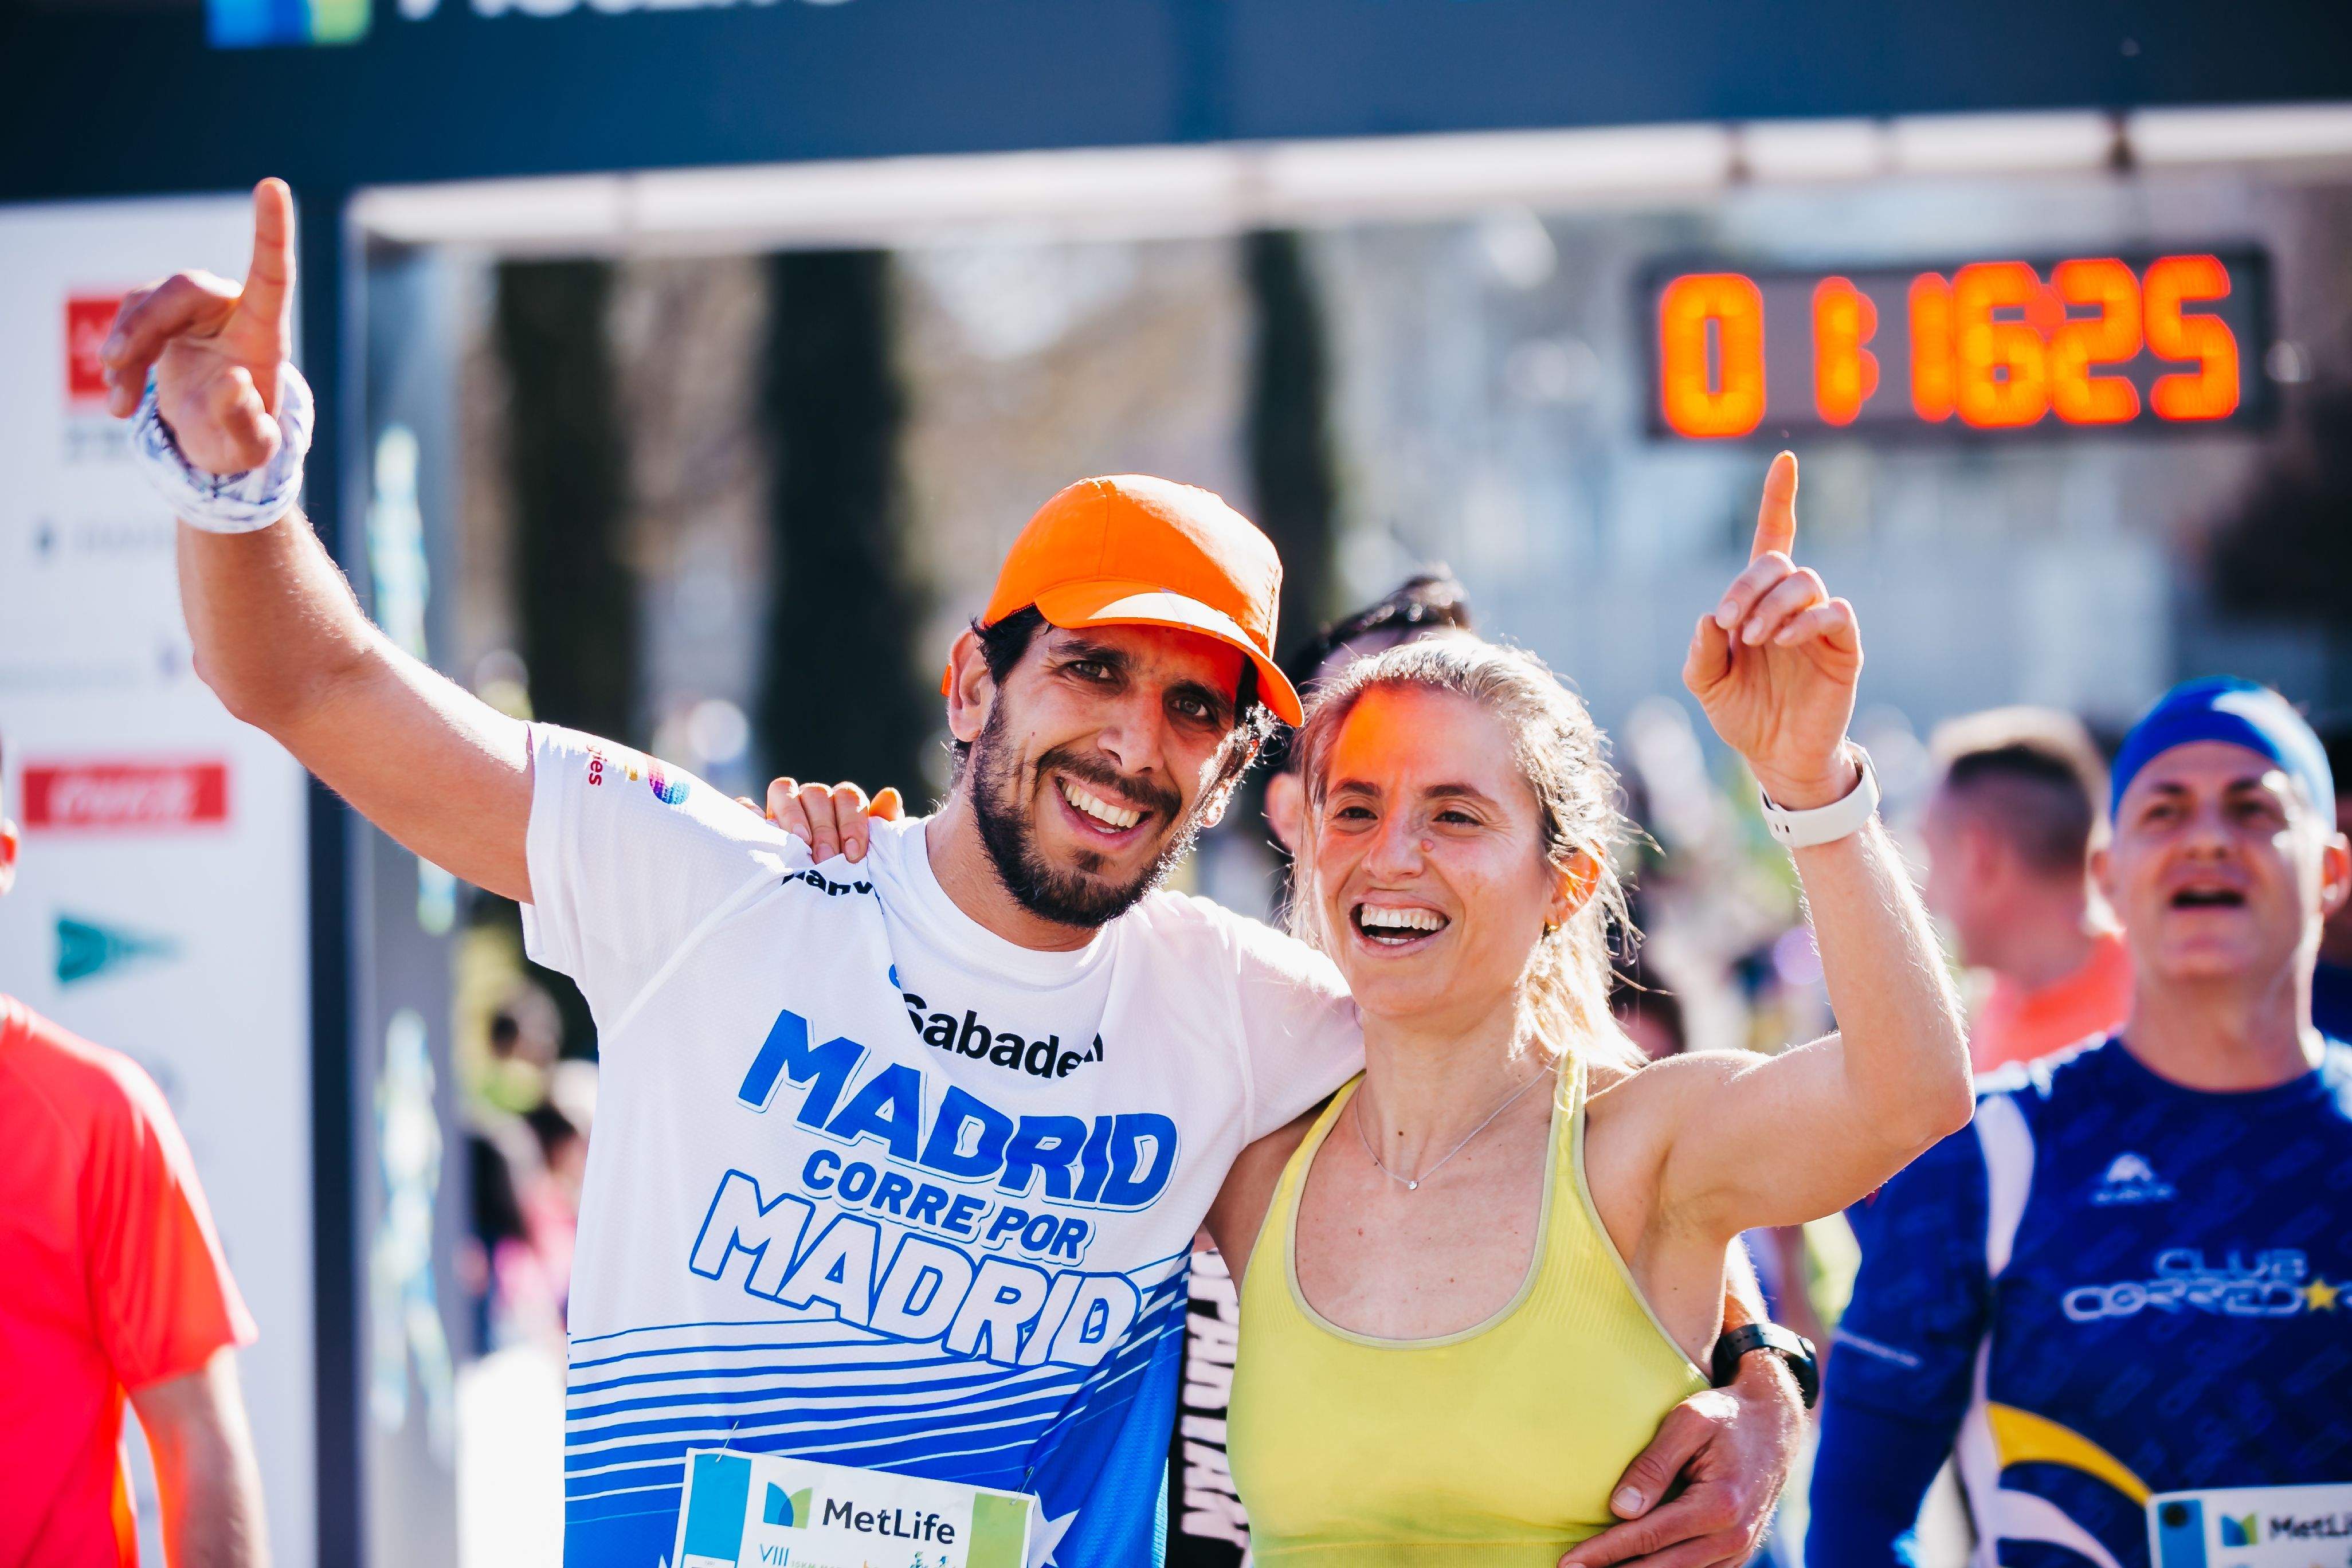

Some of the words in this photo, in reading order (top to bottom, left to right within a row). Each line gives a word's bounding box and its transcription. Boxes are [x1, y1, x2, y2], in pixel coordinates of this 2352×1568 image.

[737, 1009, 1182, 1210] MADRID
[802, 1150, 986, 1235] CORRE
[988, 1208, 1088, 1260] POR
[689, 1169, 1141, 1367] MADRID
[2155, 1248, 2307, 1279] CLUB
[760, 1543, 789, 1566] VIII
[822, 1496, 955, 1545] MetLife
